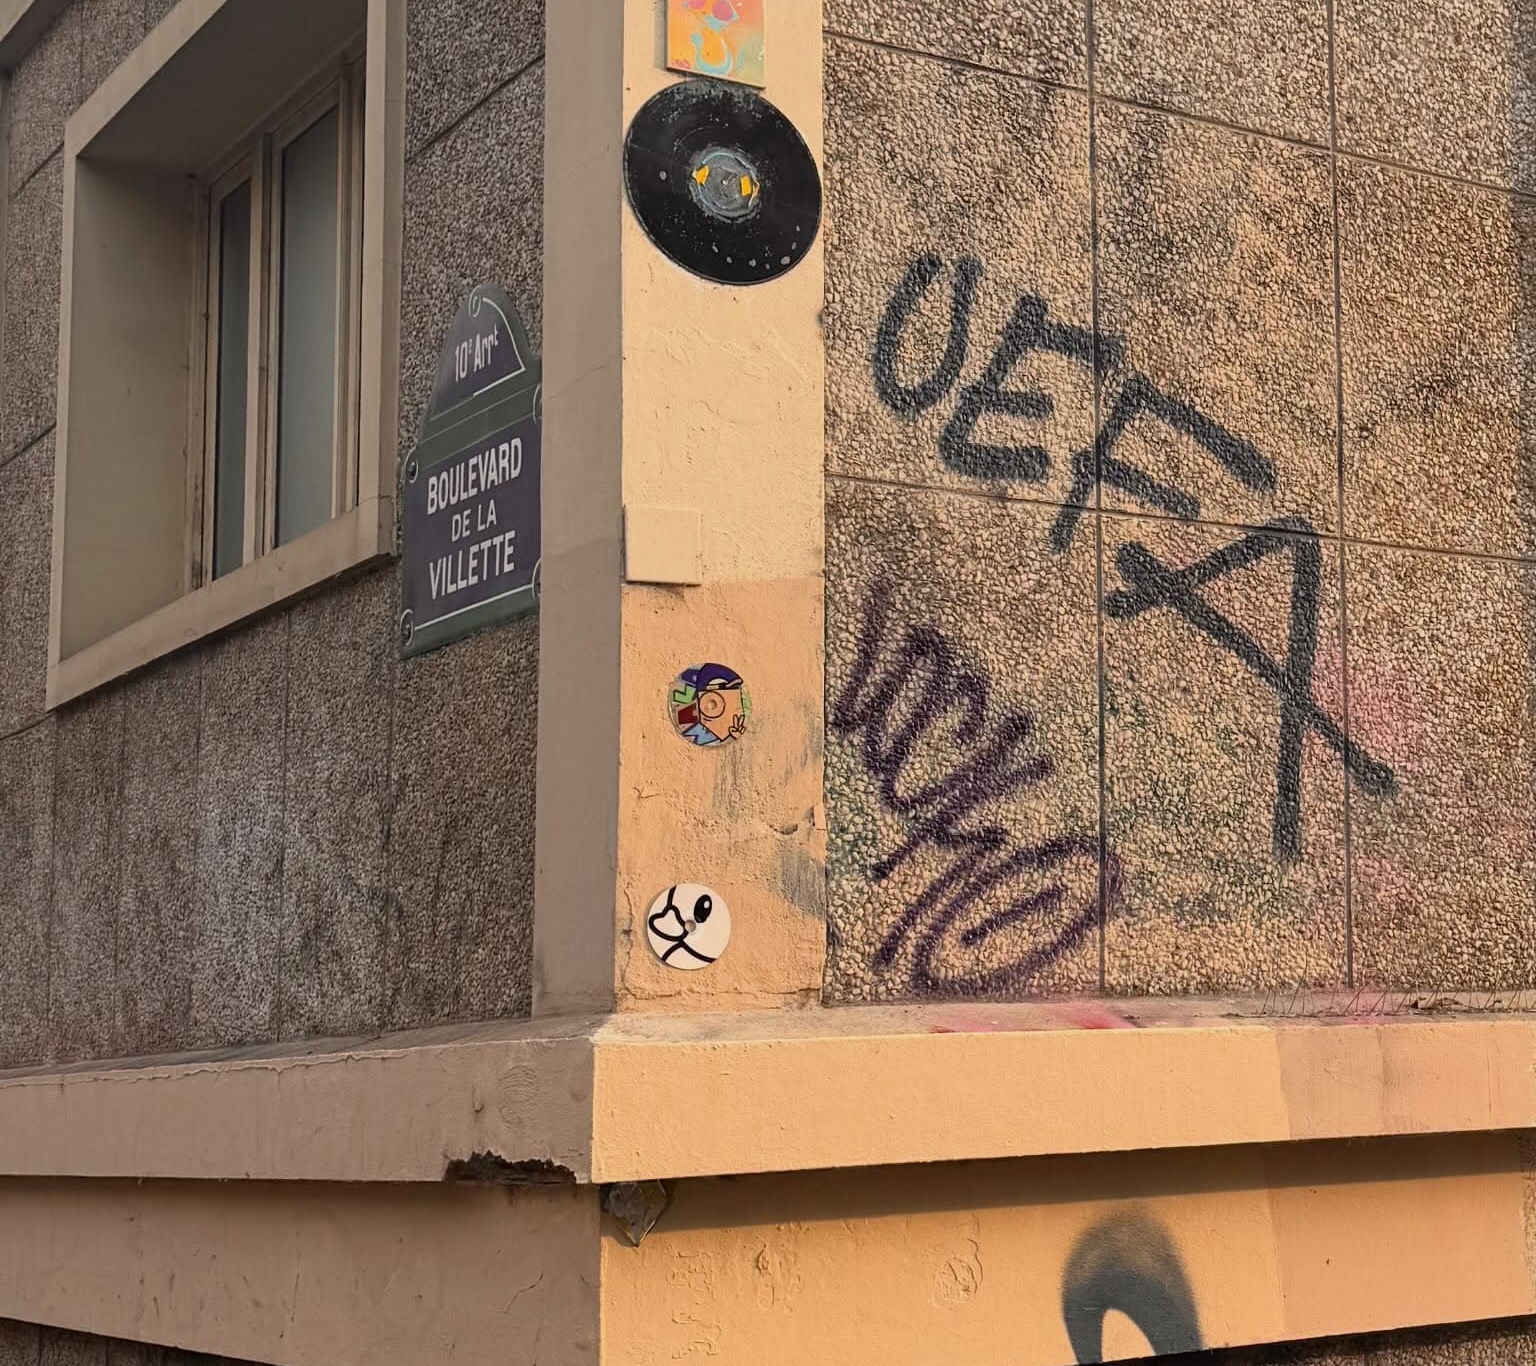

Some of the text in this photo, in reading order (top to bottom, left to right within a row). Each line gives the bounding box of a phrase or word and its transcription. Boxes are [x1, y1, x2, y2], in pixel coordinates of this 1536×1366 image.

[427, 437, 522, 515] BOULEVARD
[451, 499, 497, 542] DE LA
[429, 530, 516, 600] VILLETTE
